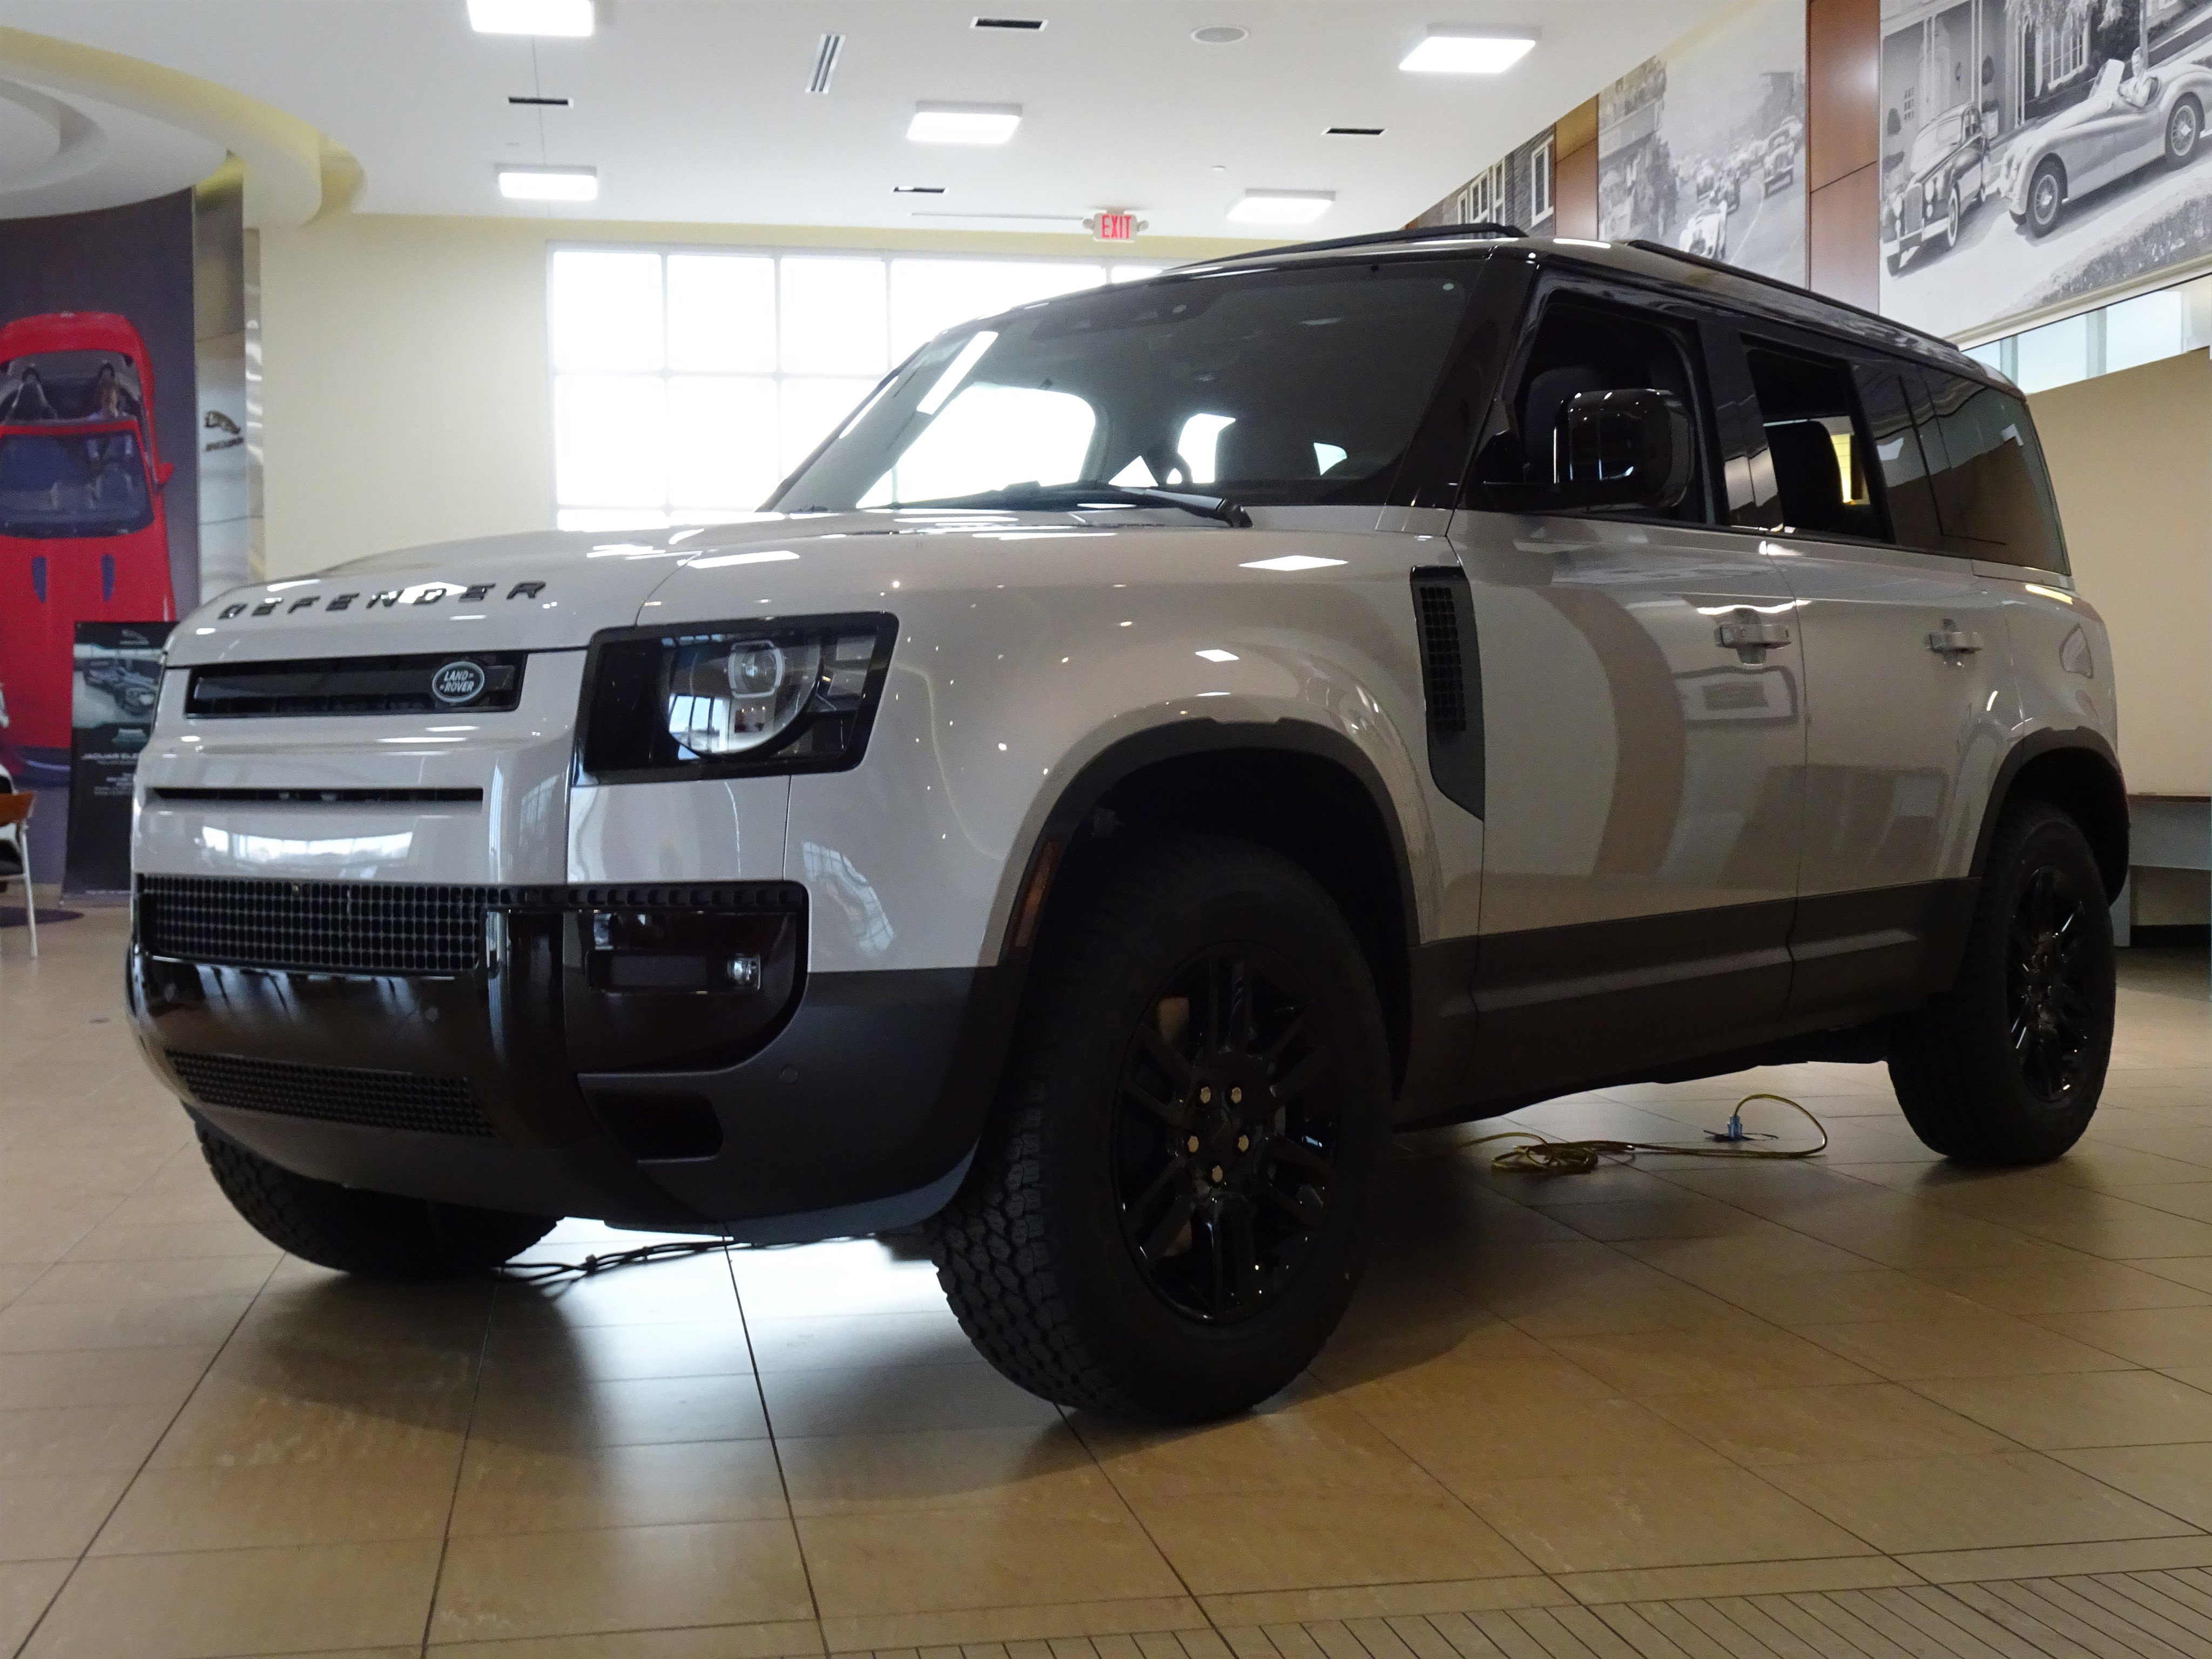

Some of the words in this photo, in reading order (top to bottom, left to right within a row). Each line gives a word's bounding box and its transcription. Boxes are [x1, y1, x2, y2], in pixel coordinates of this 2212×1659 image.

[1102, 214, 1132, 239] EXIT
[217, 581, 547, 619] DEFENDER
[444, 670, 469, 682] LAND
[444, 680, 474, 692] ROVER
